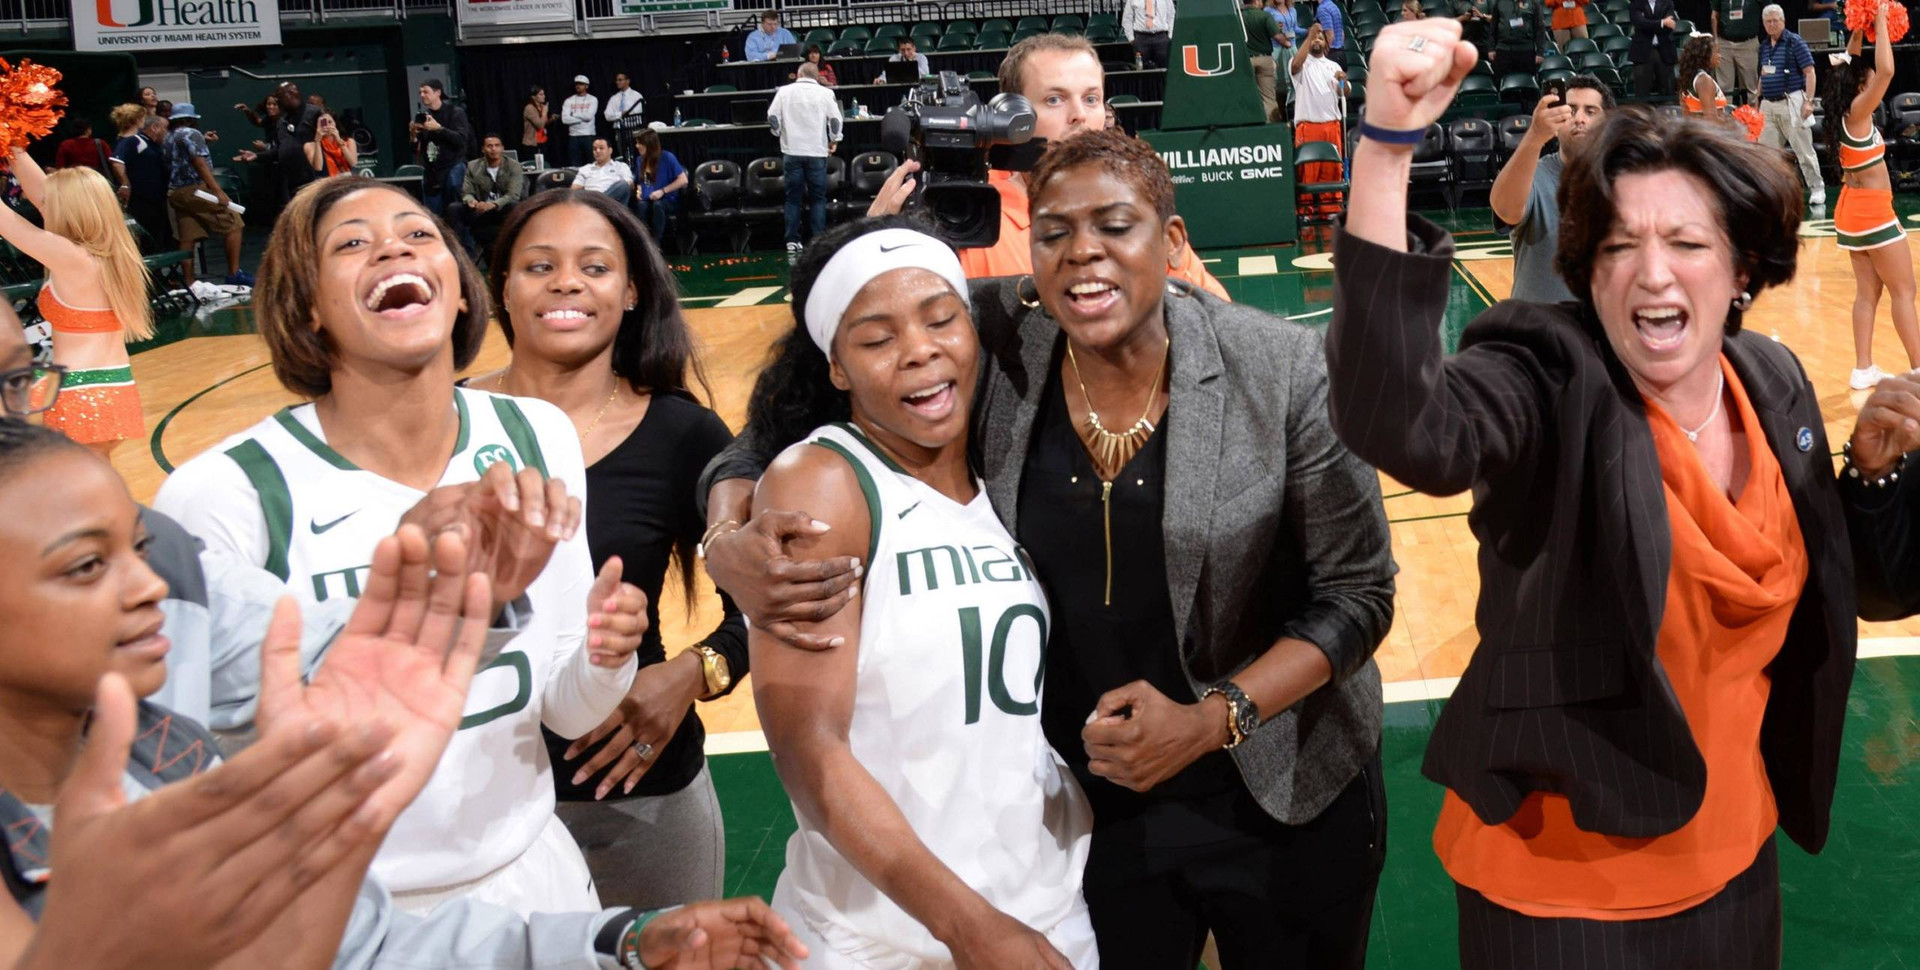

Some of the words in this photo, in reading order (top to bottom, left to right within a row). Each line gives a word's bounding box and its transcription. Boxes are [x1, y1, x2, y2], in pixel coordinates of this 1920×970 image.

[97, 35, 149, 45] UNIVERSITY
[151, 34, 163, 43] OF
[164, 33, 193, 42] MIAMI
[195, 32, 227, 41] HEALTH
[228, 31, 262, 40] SYSTEM
[1201, 171, 1234, 182] BUICK
[1240, 167, 1283, 180] GMC
[957, 603, 1047, 725] 10
